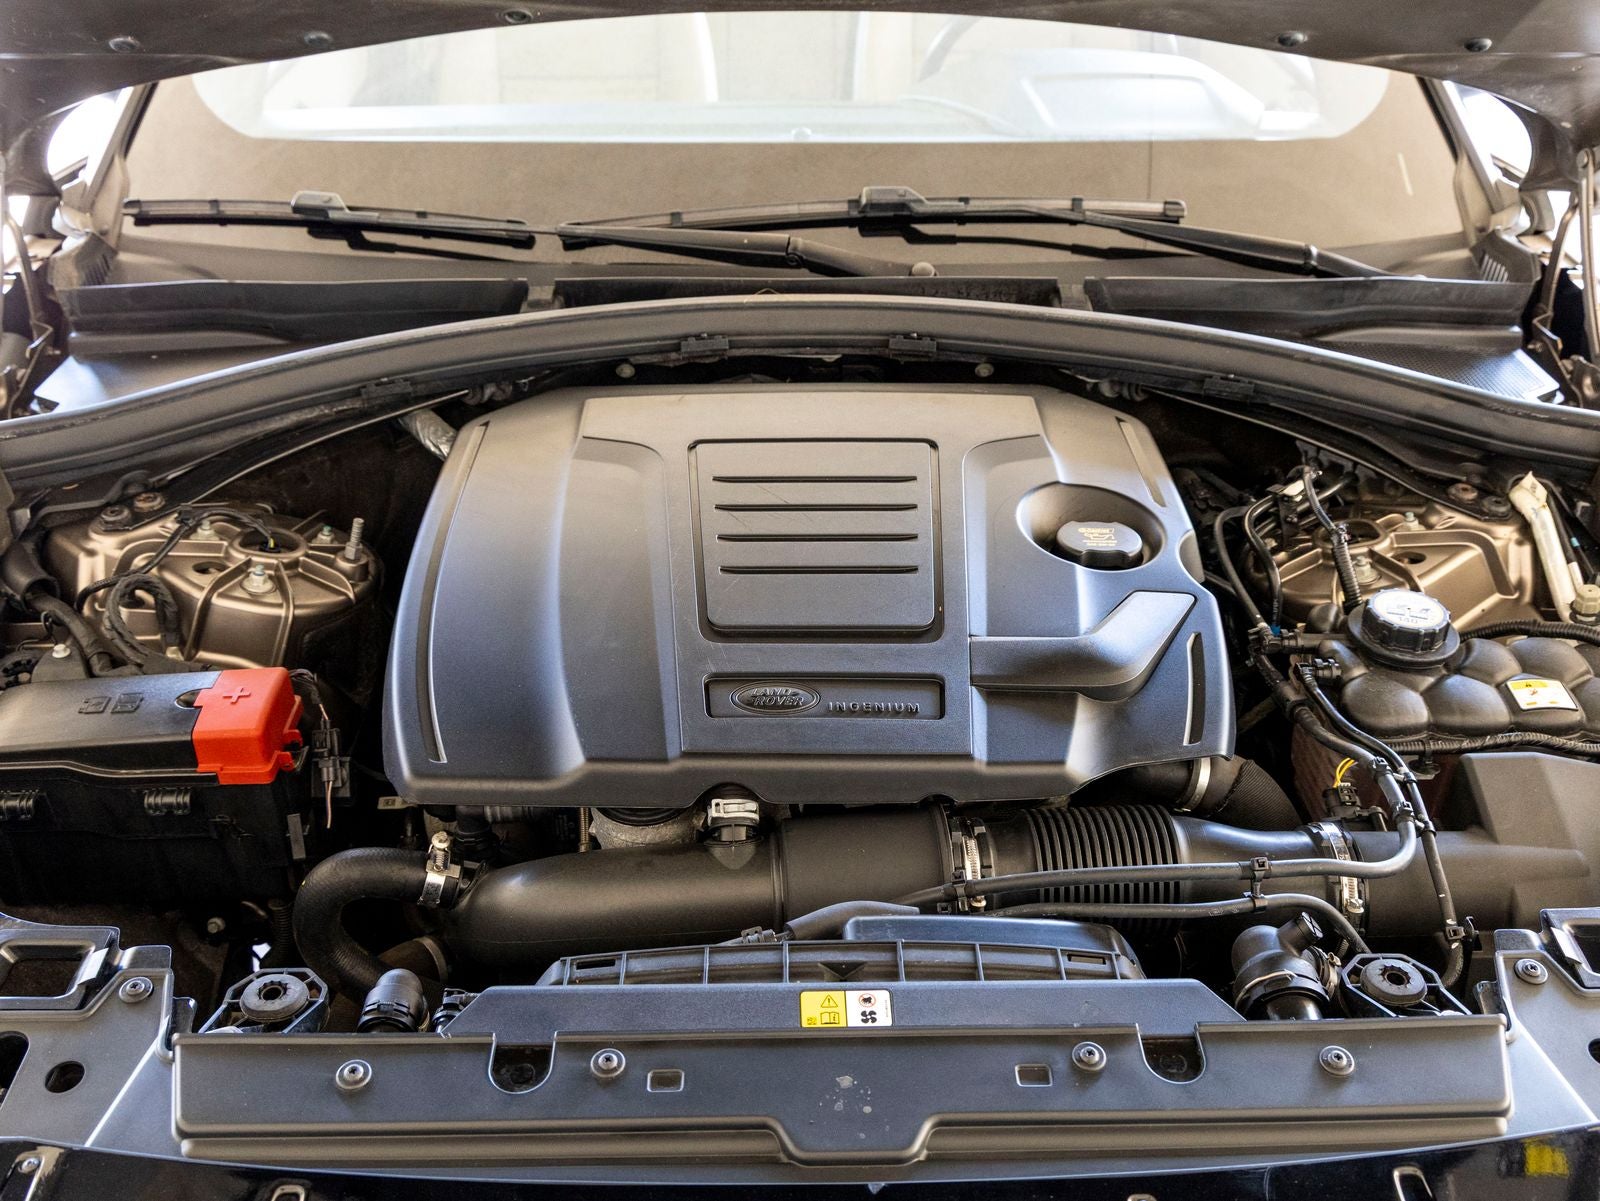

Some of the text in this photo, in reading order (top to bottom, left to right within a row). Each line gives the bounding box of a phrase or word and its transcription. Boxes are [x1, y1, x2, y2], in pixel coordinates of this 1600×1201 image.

[752, 688, 793, 696] LAND
[753, 696, 804, 706] ROVER
[828, 701, 920, 713] INGENIUM
